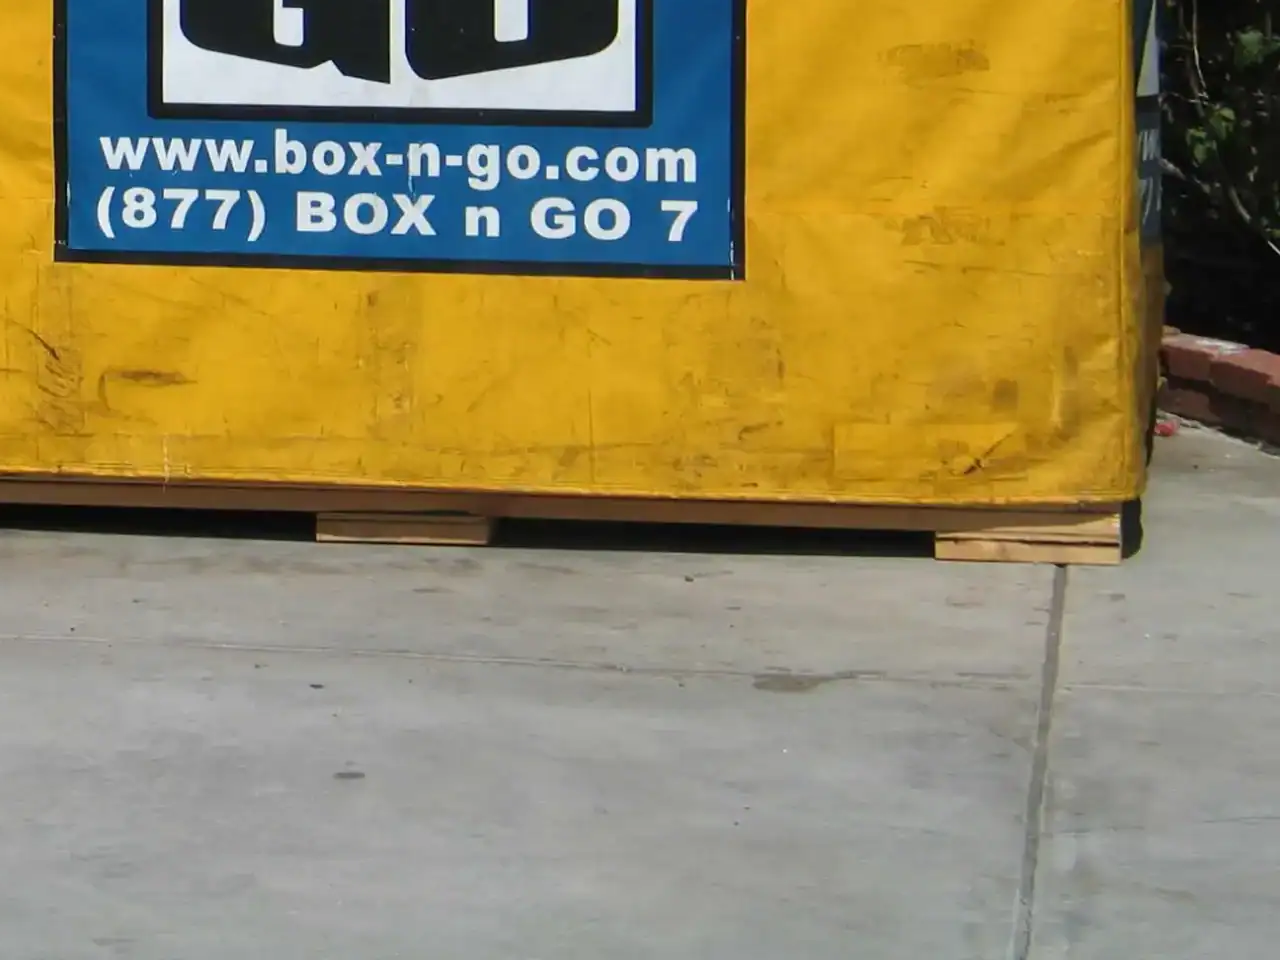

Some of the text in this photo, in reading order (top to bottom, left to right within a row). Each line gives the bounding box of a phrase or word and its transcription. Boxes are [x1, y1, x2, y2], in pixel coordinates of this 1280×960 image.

[99, 128, 697, 191] www.box-n-go.com
[97, 186, 698, 242] (877) BOX n GO 7
